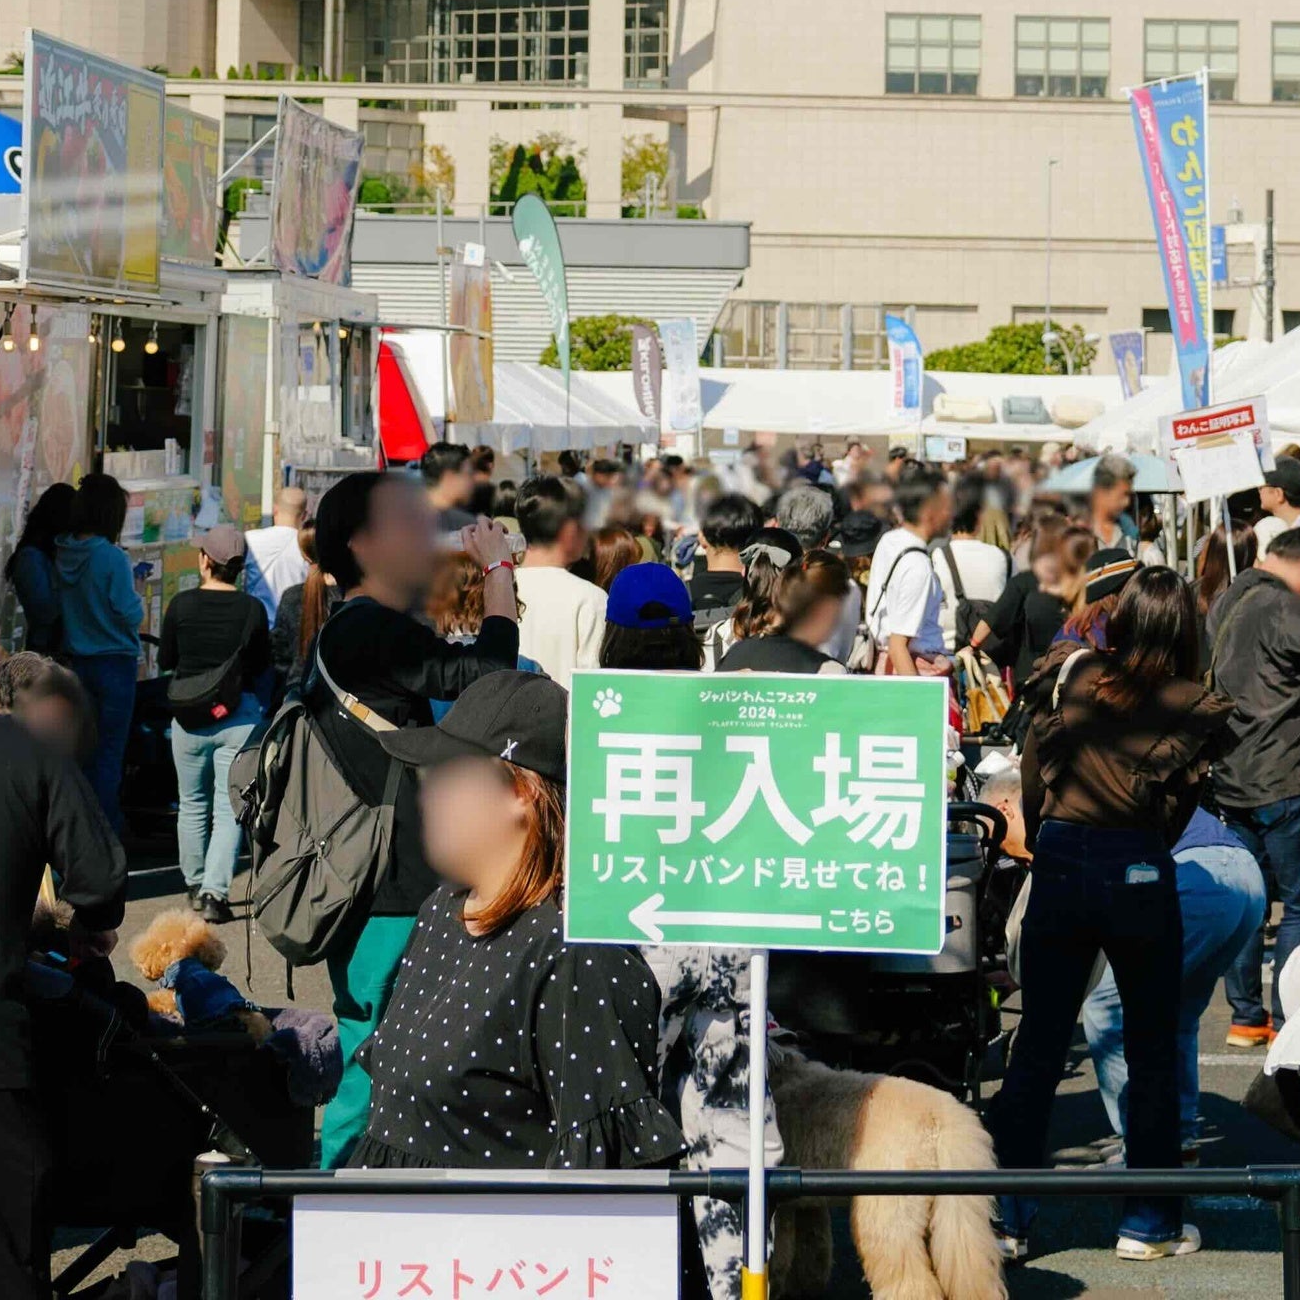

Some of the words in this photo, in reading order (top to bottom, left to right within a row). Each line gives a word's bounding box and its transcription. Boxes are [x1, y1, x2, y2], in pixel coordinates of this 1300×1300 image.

[738, 706, 777, 719] 2024
[591, 731, 926, 852] 再入場
[591, 853, 928, 893] リストバンド見せてね！
[826, 908, 896, 935] こちら
[356, 1256, 615, 1299] リストバンド
